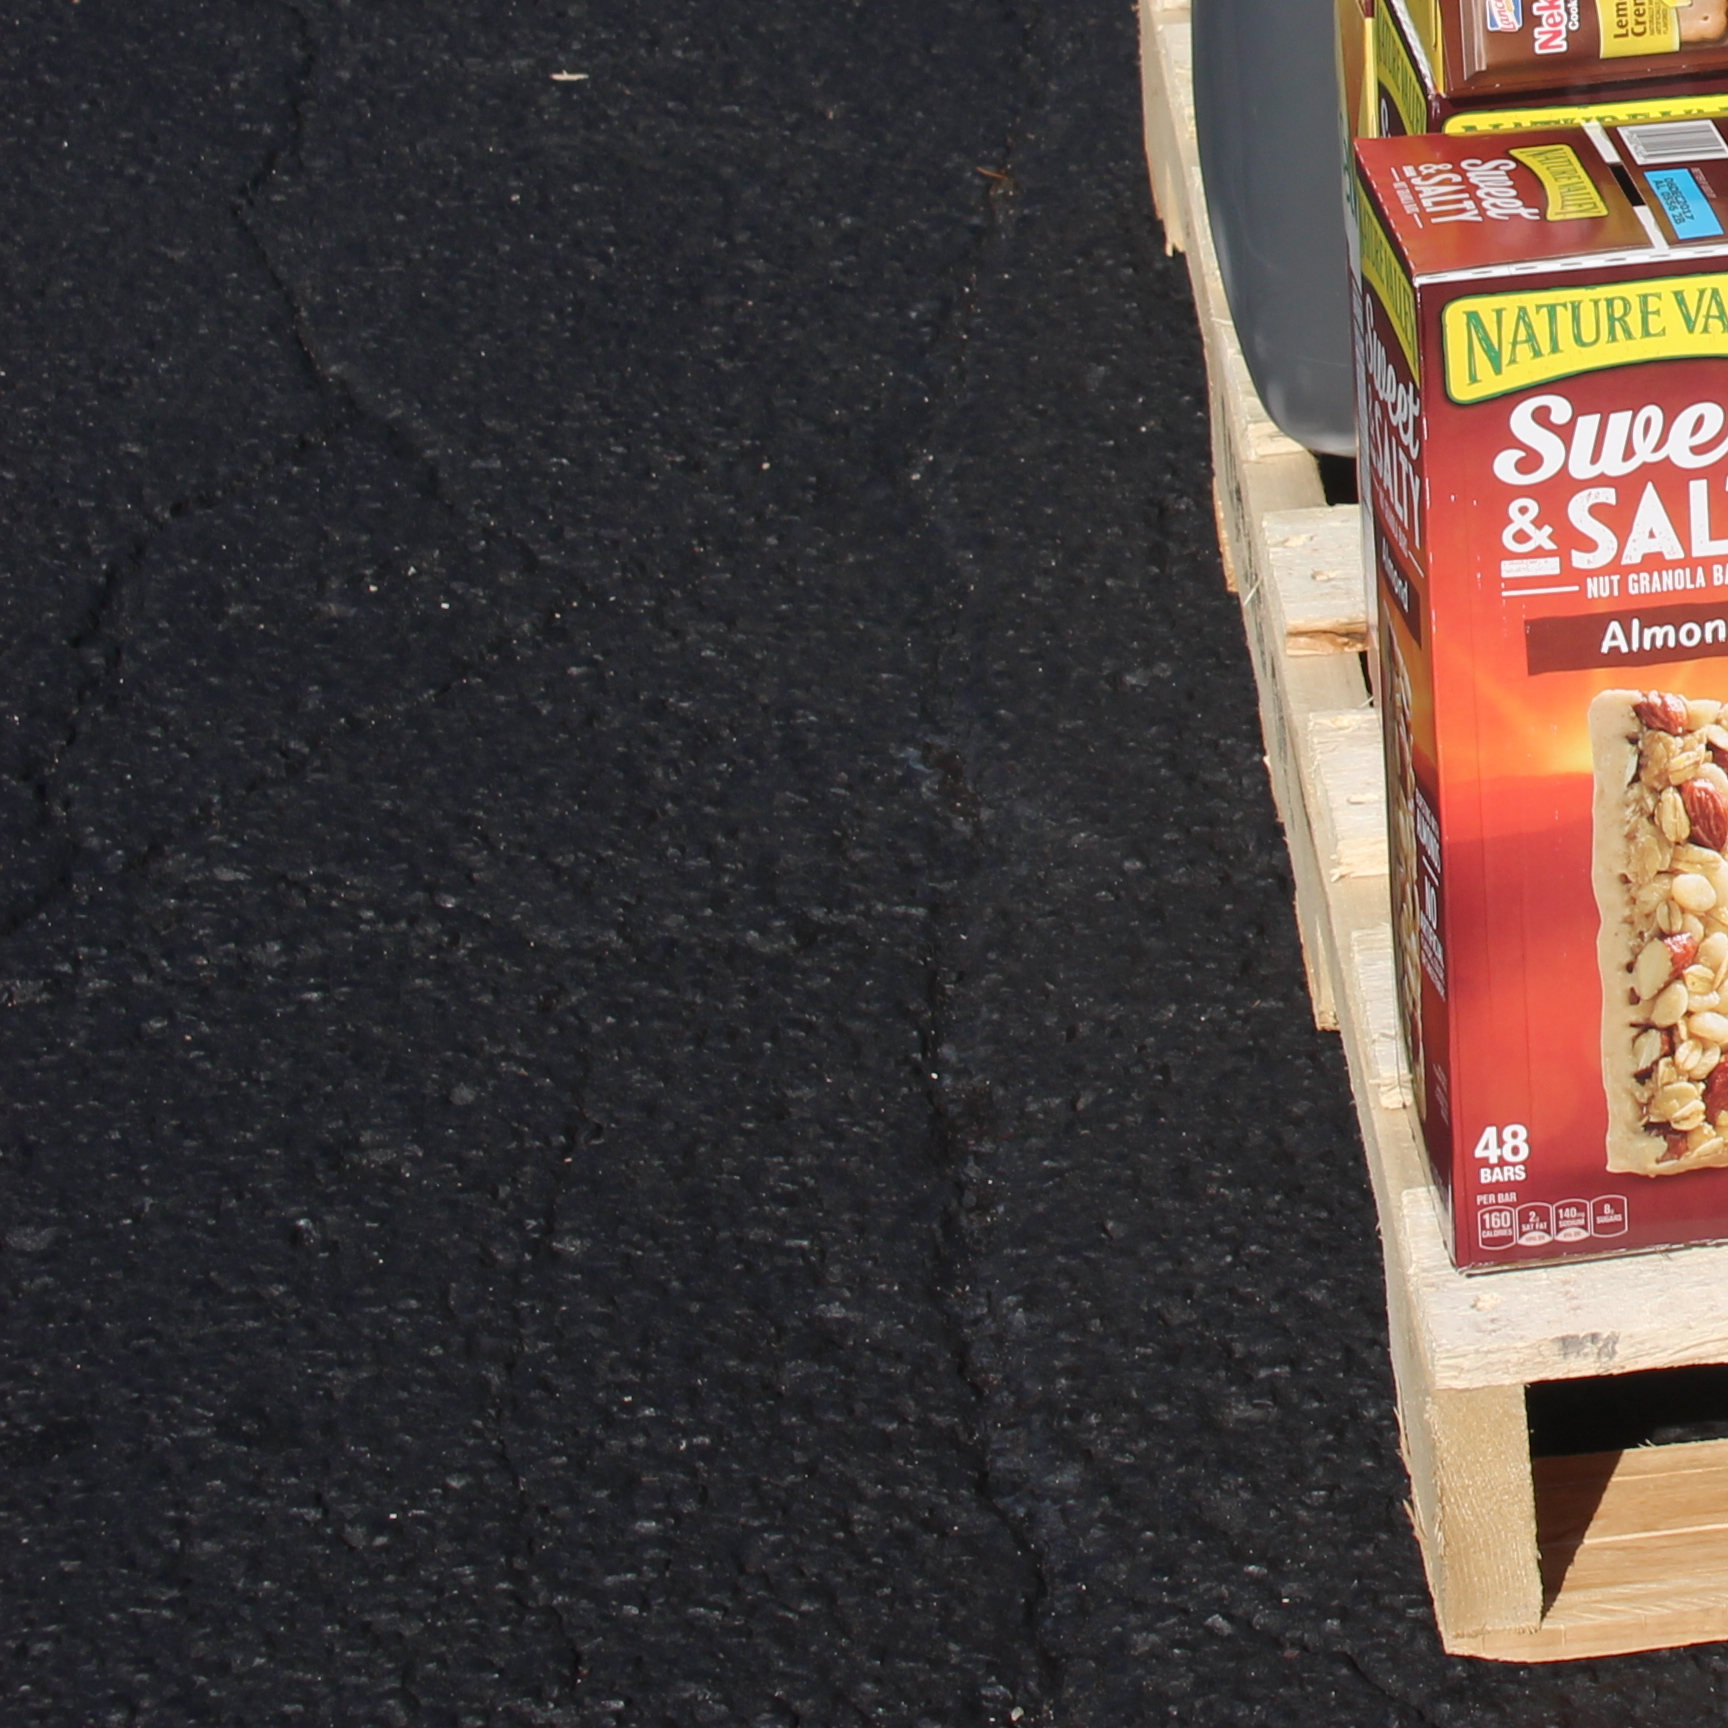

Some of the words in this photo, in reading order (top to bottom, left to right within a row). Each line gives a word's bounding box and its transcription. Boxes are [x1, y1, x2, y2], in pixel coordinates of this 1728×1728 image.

[1464, 292, 1666, 384] NATURE
[1501, 498, 1559, 553] &
[1586, 576, 1620, 598] NUT
[1628, 568, 1706, 594] GRANOLA
[1474, 1124, 1530, 1163] 48
[1480, 1164, 1526, 1183] BARS
